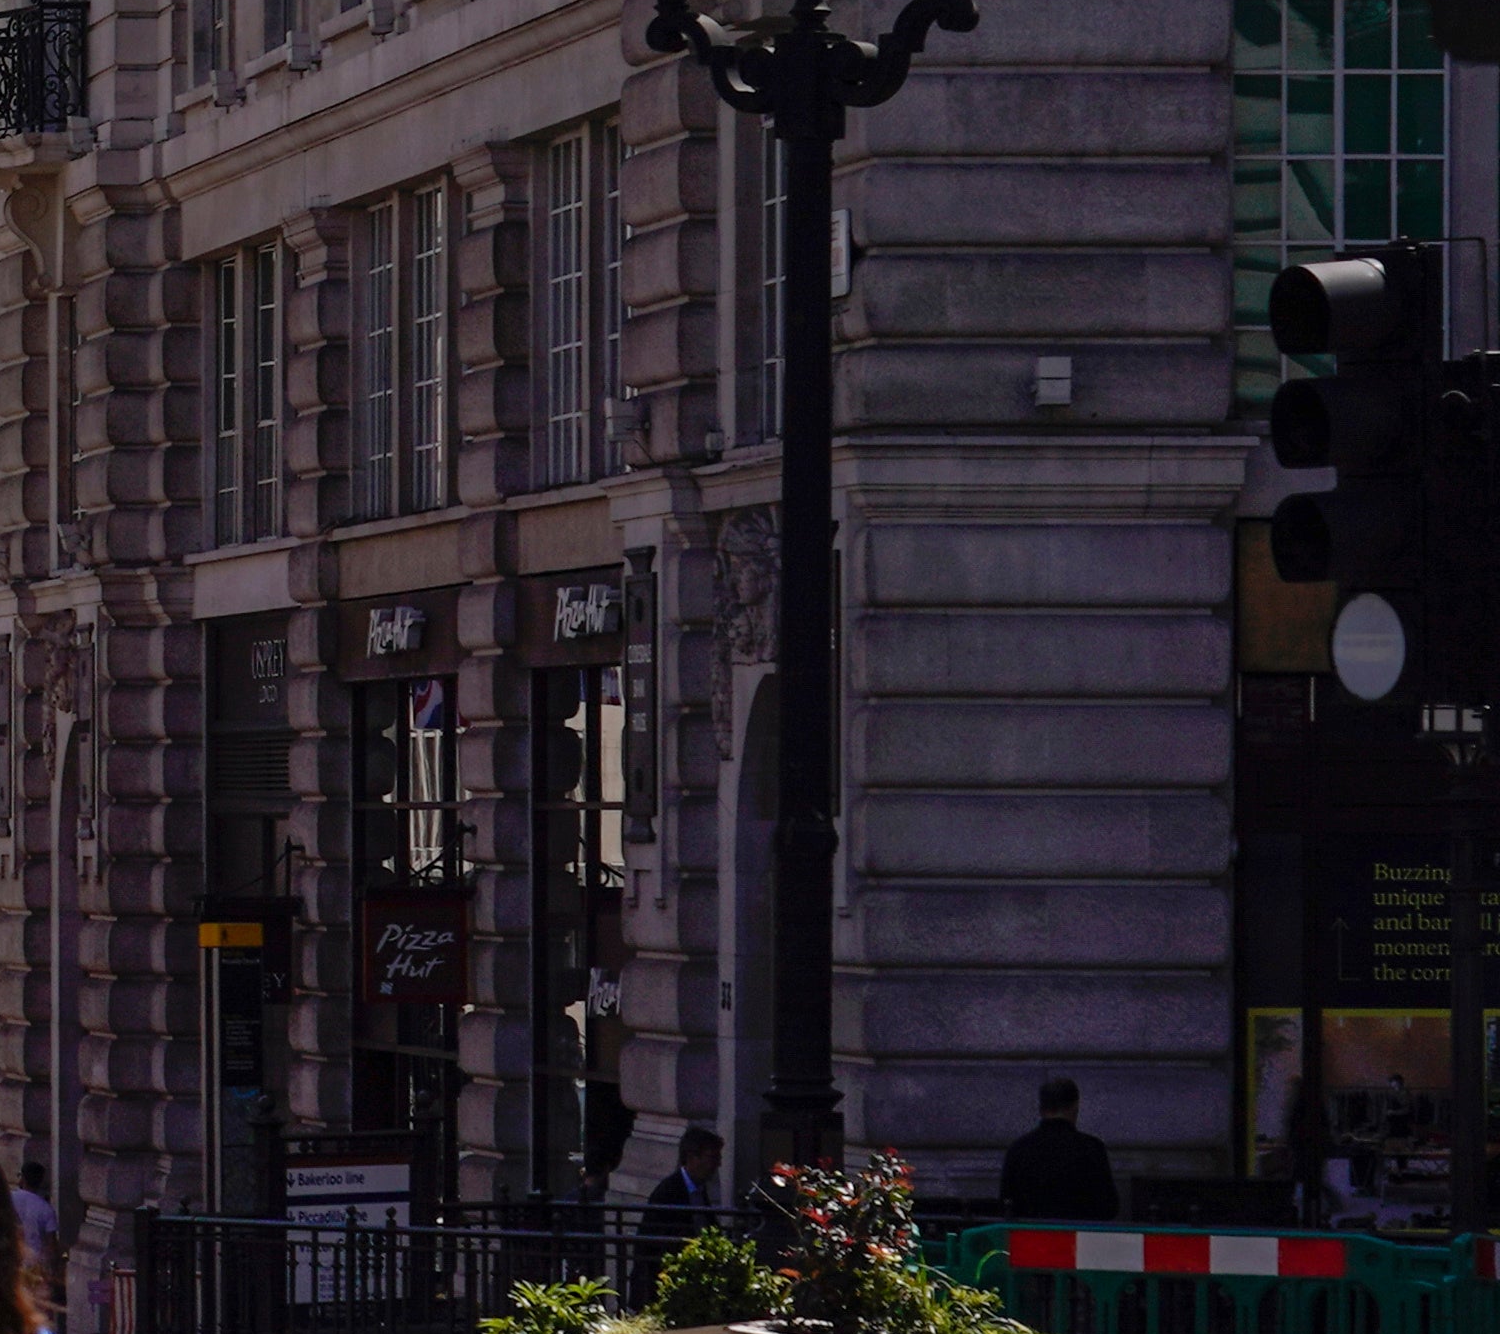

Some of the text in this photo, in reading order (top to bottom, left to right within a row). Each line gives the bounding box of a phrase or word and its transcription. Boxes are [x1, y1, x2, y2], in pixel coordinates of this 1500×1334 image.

[1373, 888, 1445, 910] unique
[1373, 913, 1412, 931] and
[1417, 913, 1452, 931] bar
[376, 923, 455, 954] Pizza
[386, 954, 445, 979] Hut
[1373, 962, 1407, 981] the
[298, 1172, 365, 1186] Bakerloo line
